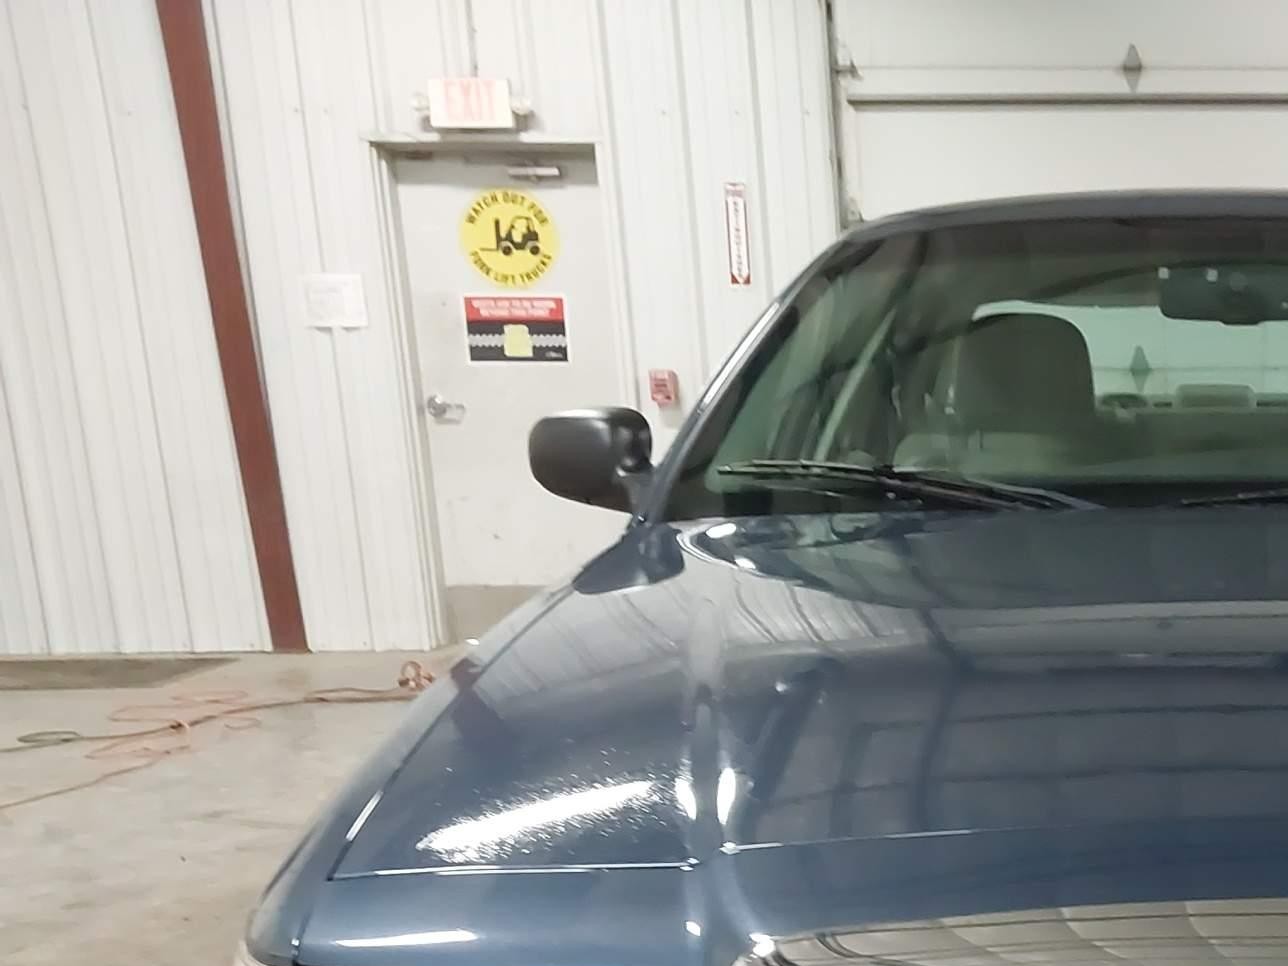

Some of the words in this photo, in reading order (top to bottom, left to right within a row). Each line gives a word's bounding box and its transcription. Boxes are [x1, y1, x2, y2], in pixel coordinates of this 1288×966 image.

[442, 79, 497, 121] EXIT
[465, 191, 499, 224] WATCH
[502, 191, 526, 206] OUT
[527, 201, 549, 225] FOR
[520, 253, 552, 284] TRUCKS
